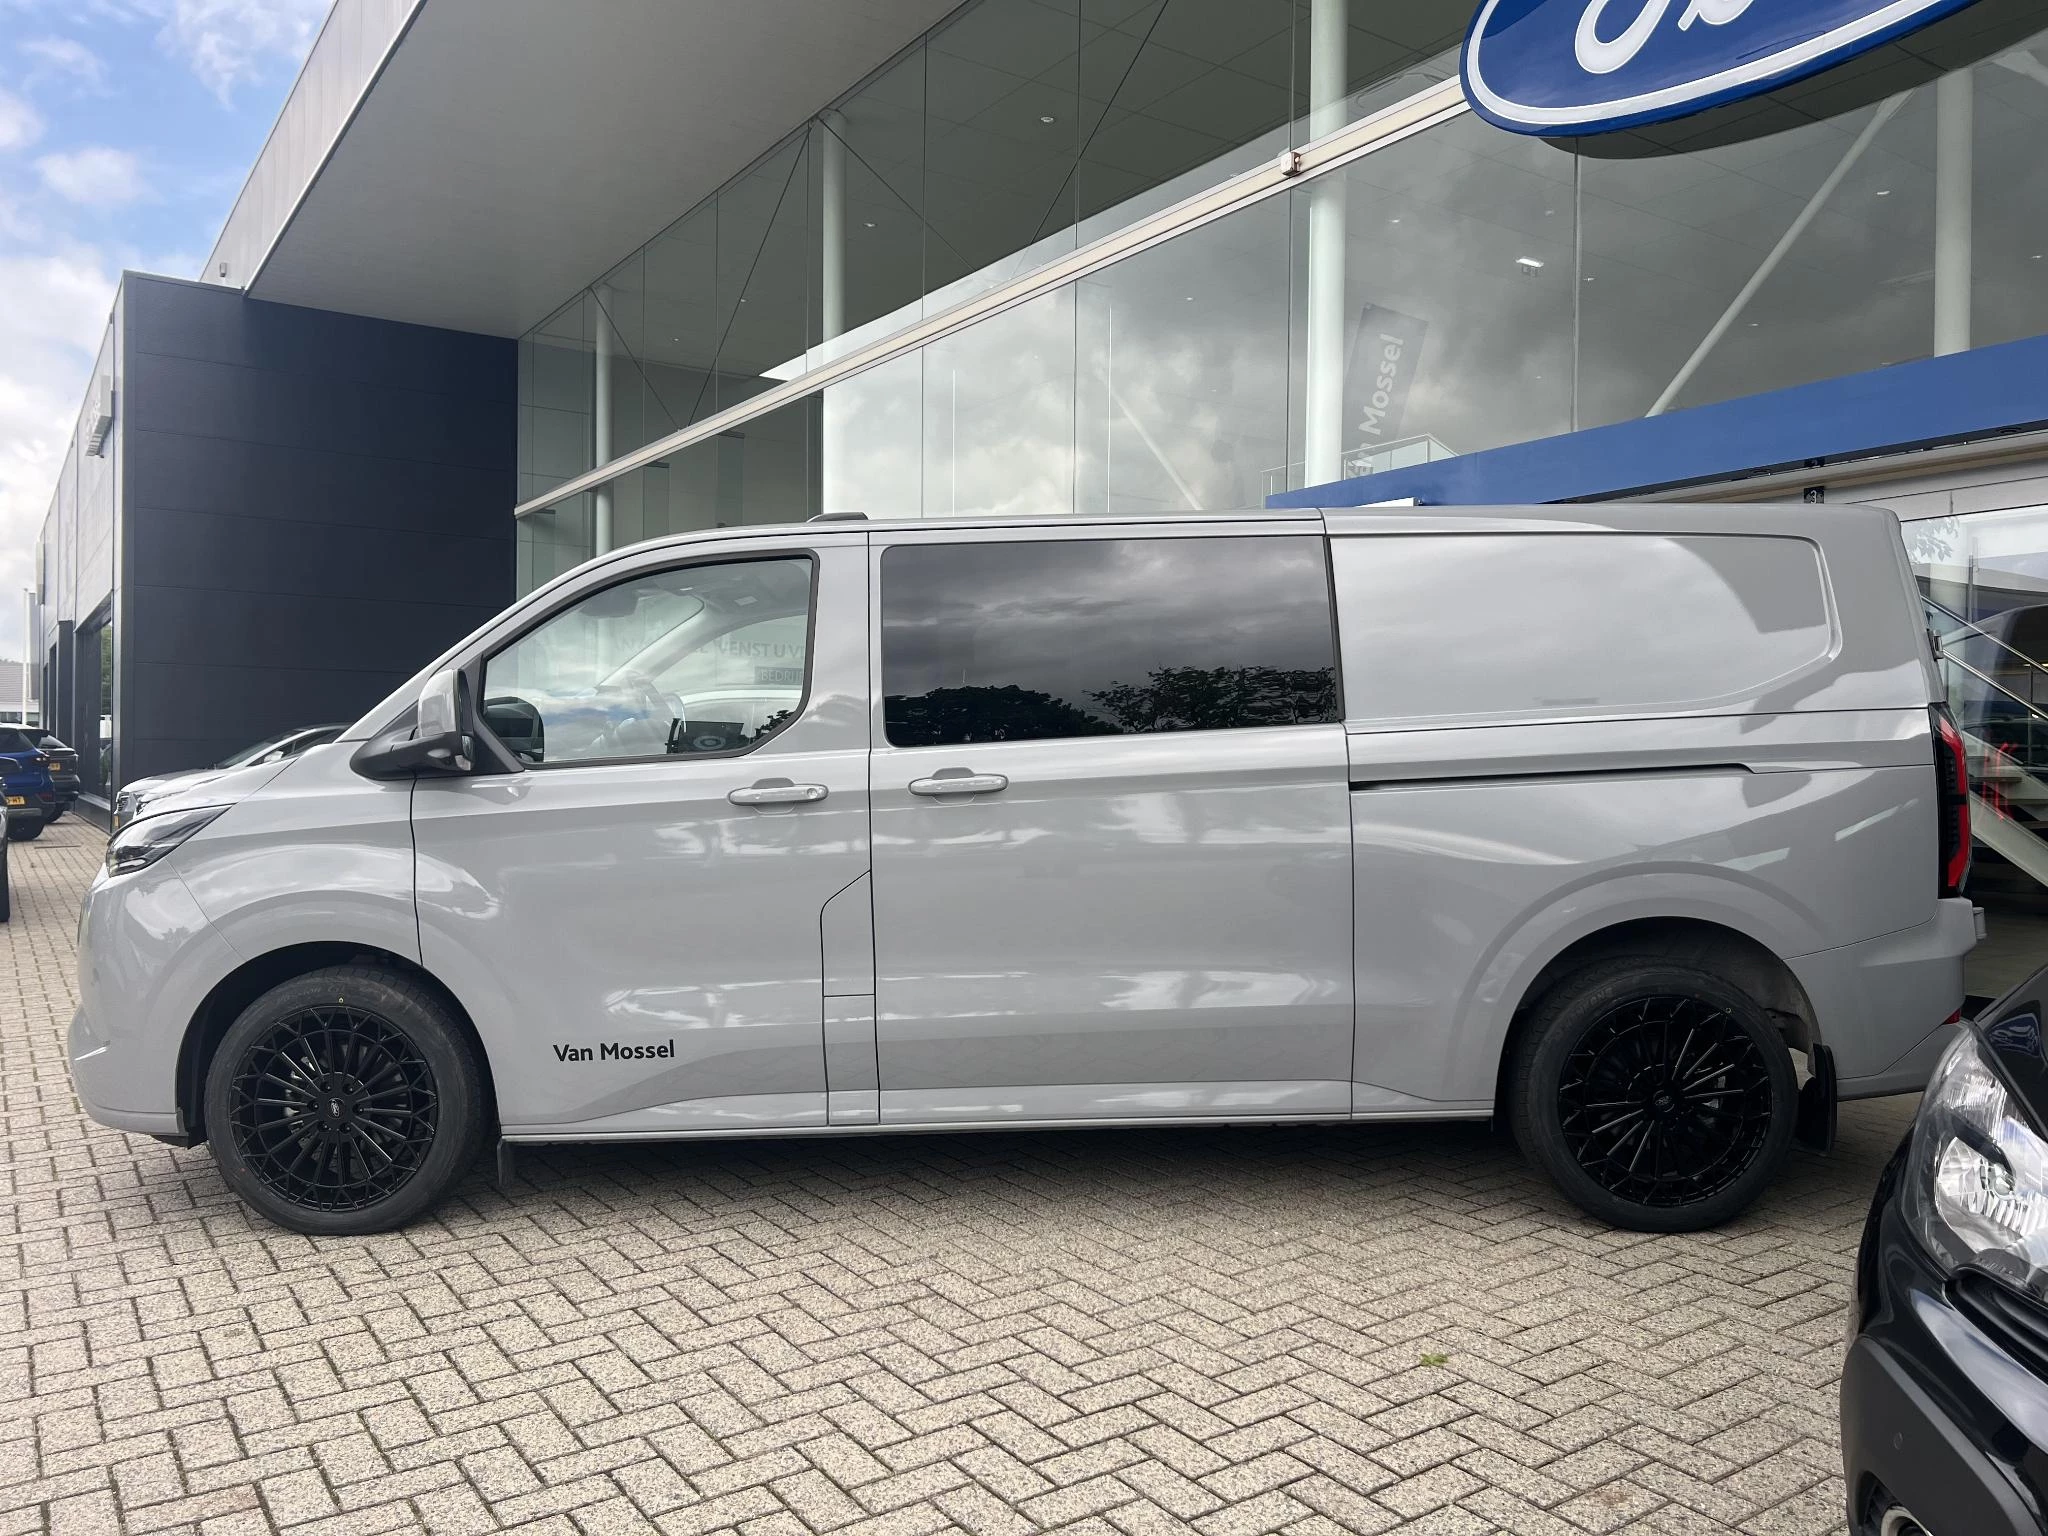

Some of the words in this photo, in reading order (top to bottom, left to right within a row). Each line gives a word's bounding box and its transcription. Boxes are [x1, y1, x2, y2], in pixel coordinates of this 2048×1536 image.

[1358, 334, 1404, 435] Mossel
[553, 1044, 593, 1061] Van
[600, 1039, 675, 1060] Mossel
